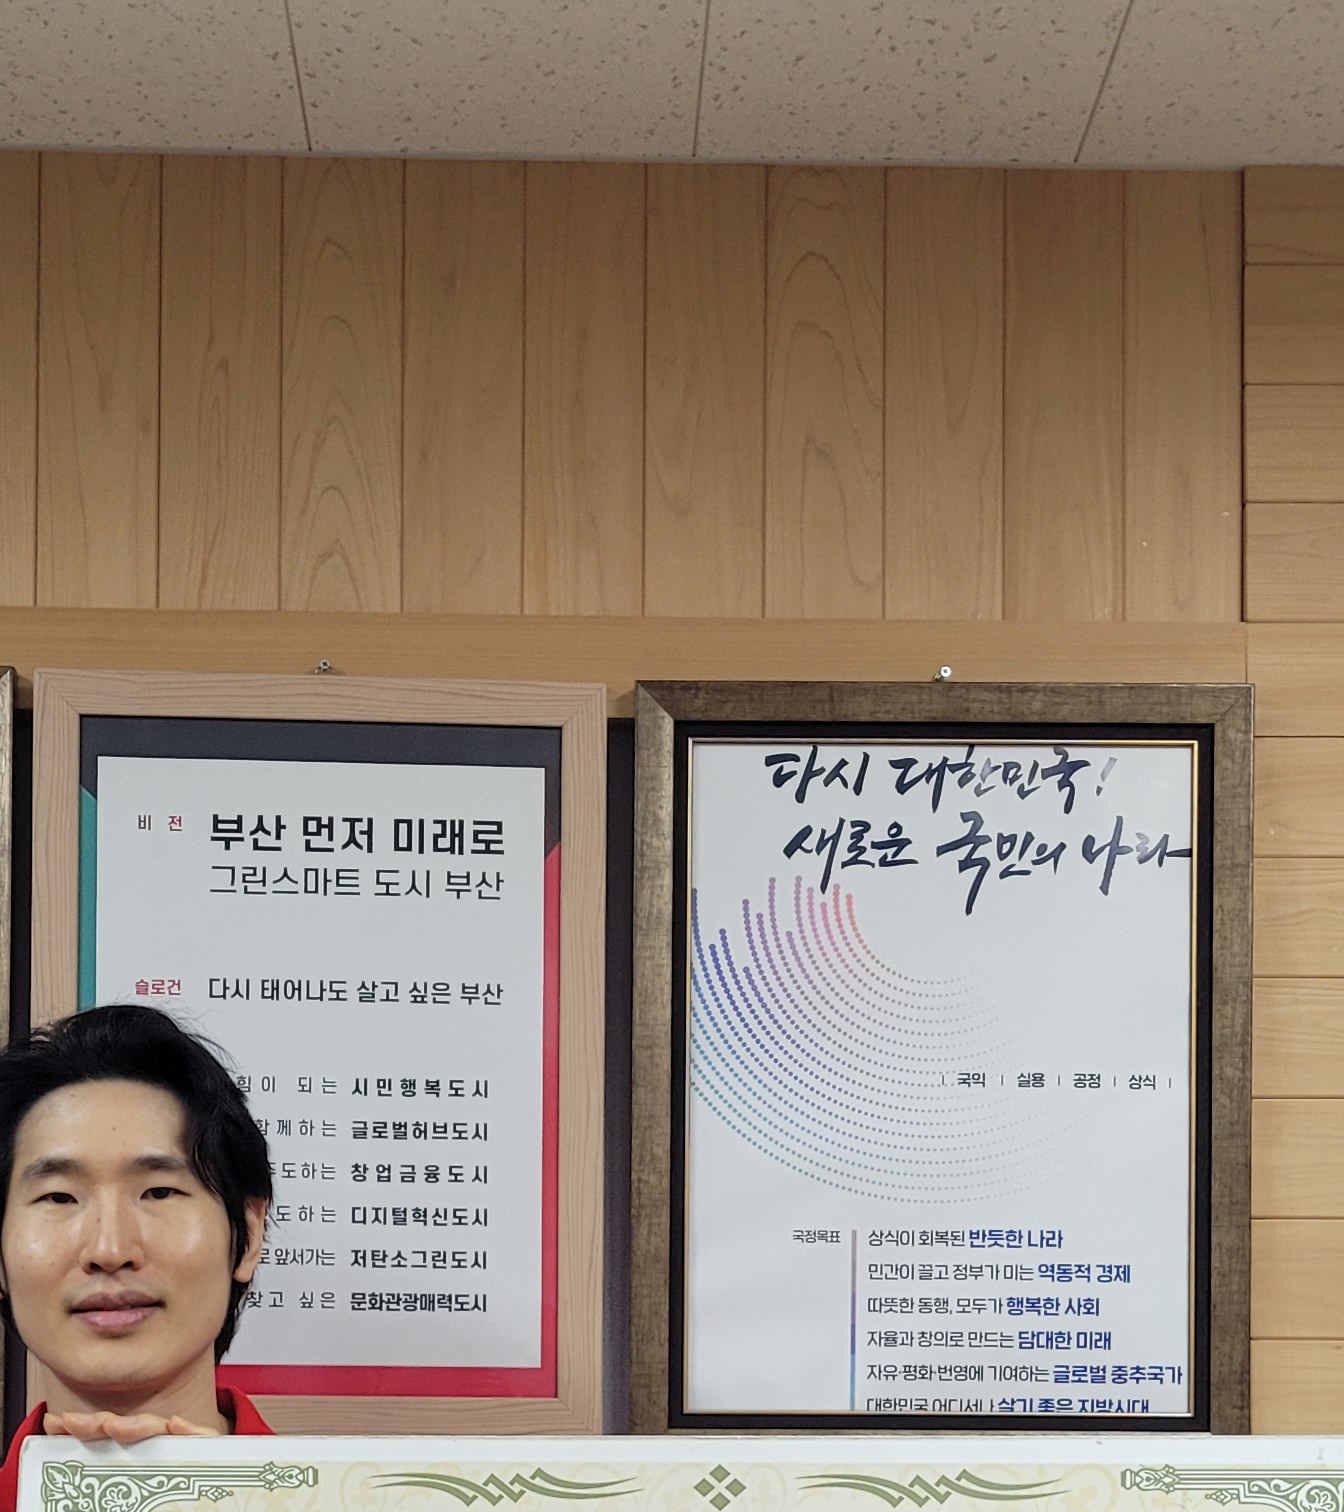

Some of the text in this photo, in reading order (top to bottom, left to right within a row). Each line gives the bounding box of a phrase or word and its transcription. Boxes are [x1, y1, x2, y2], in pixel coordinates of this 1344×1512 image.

[765, 744, 1118, 814] 다시 대한민국!
[210, 814, 504, 855] 부산 먼저 미래로
[784, 811, 1191, 915] 새로운 국민의 나라
[210, 866, 504, 900] 그린스마트 도시 부산
[135, 979, 181, 995] 슬로건
[209, 978, 503, 1005] 다시 태어나도 살고 싶은 부산
[298, 1077, 336, 1094] 되는
[352, 1078, 488, 1098] 시민행복도시
[957, 1073, 1157, 1090] 국익 실용 공정 상식
[352, 1121, 487, 1141] 글로벌허브도시
[351, 1163, 487, 1184] 창업금융도시
[352, 1206, 487, 1226] 디지털혁신도시
[792, 1230, 840, 1243] 국정목표
[868, 1229, 1063, 1248] 상식이 회복된 반듯한 나라
[351, 1249, 486, 1269] 저탄소그린도시
[868, 1263, 1130, 1283] 민간이 끌고 정부가 미는 역동적 경제
[299, 1291, 335, 1308] 싶은
[350, 1292, 486, 1312] 문화관광매력도시
[868, 1296, 1099, 1316] 따뜻한 동행, 모두가 행복한 사회
[867, 1331, 1111, 1350] 자율과 창의로 만드는 담대한 미래
[987, 1365, 1049, 1382] 기여하는
[1053, 1365, 1106, 1383] 글로벌
[1111, 1365, 1182, 1384] 중추국가
